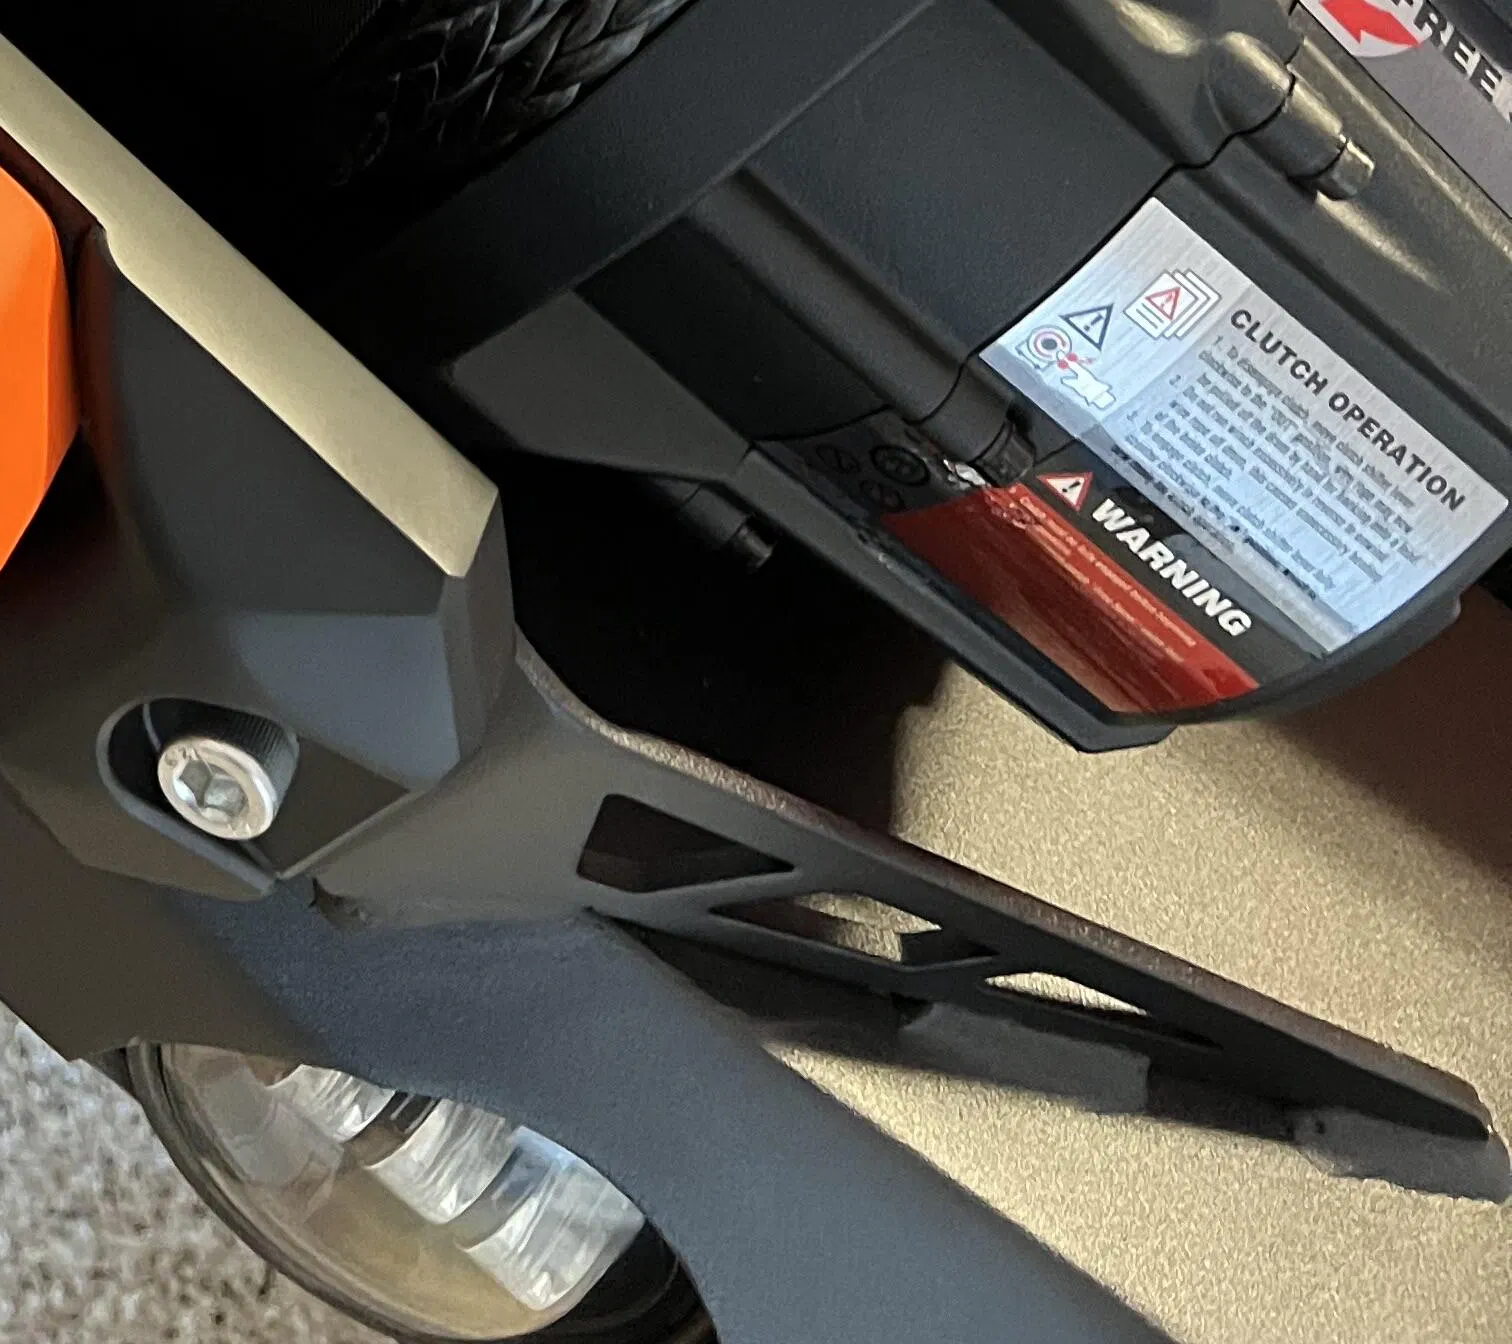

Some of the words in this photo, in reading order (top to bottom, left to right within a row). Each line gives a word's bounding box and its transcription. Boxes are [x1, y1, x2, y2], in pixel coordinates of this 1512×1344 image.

[1229, 308, 1326, 397] CLUTCH
[1327, 392, 1465, 512] OPERATION
[1091, 498, 1253, 637] WARNING
